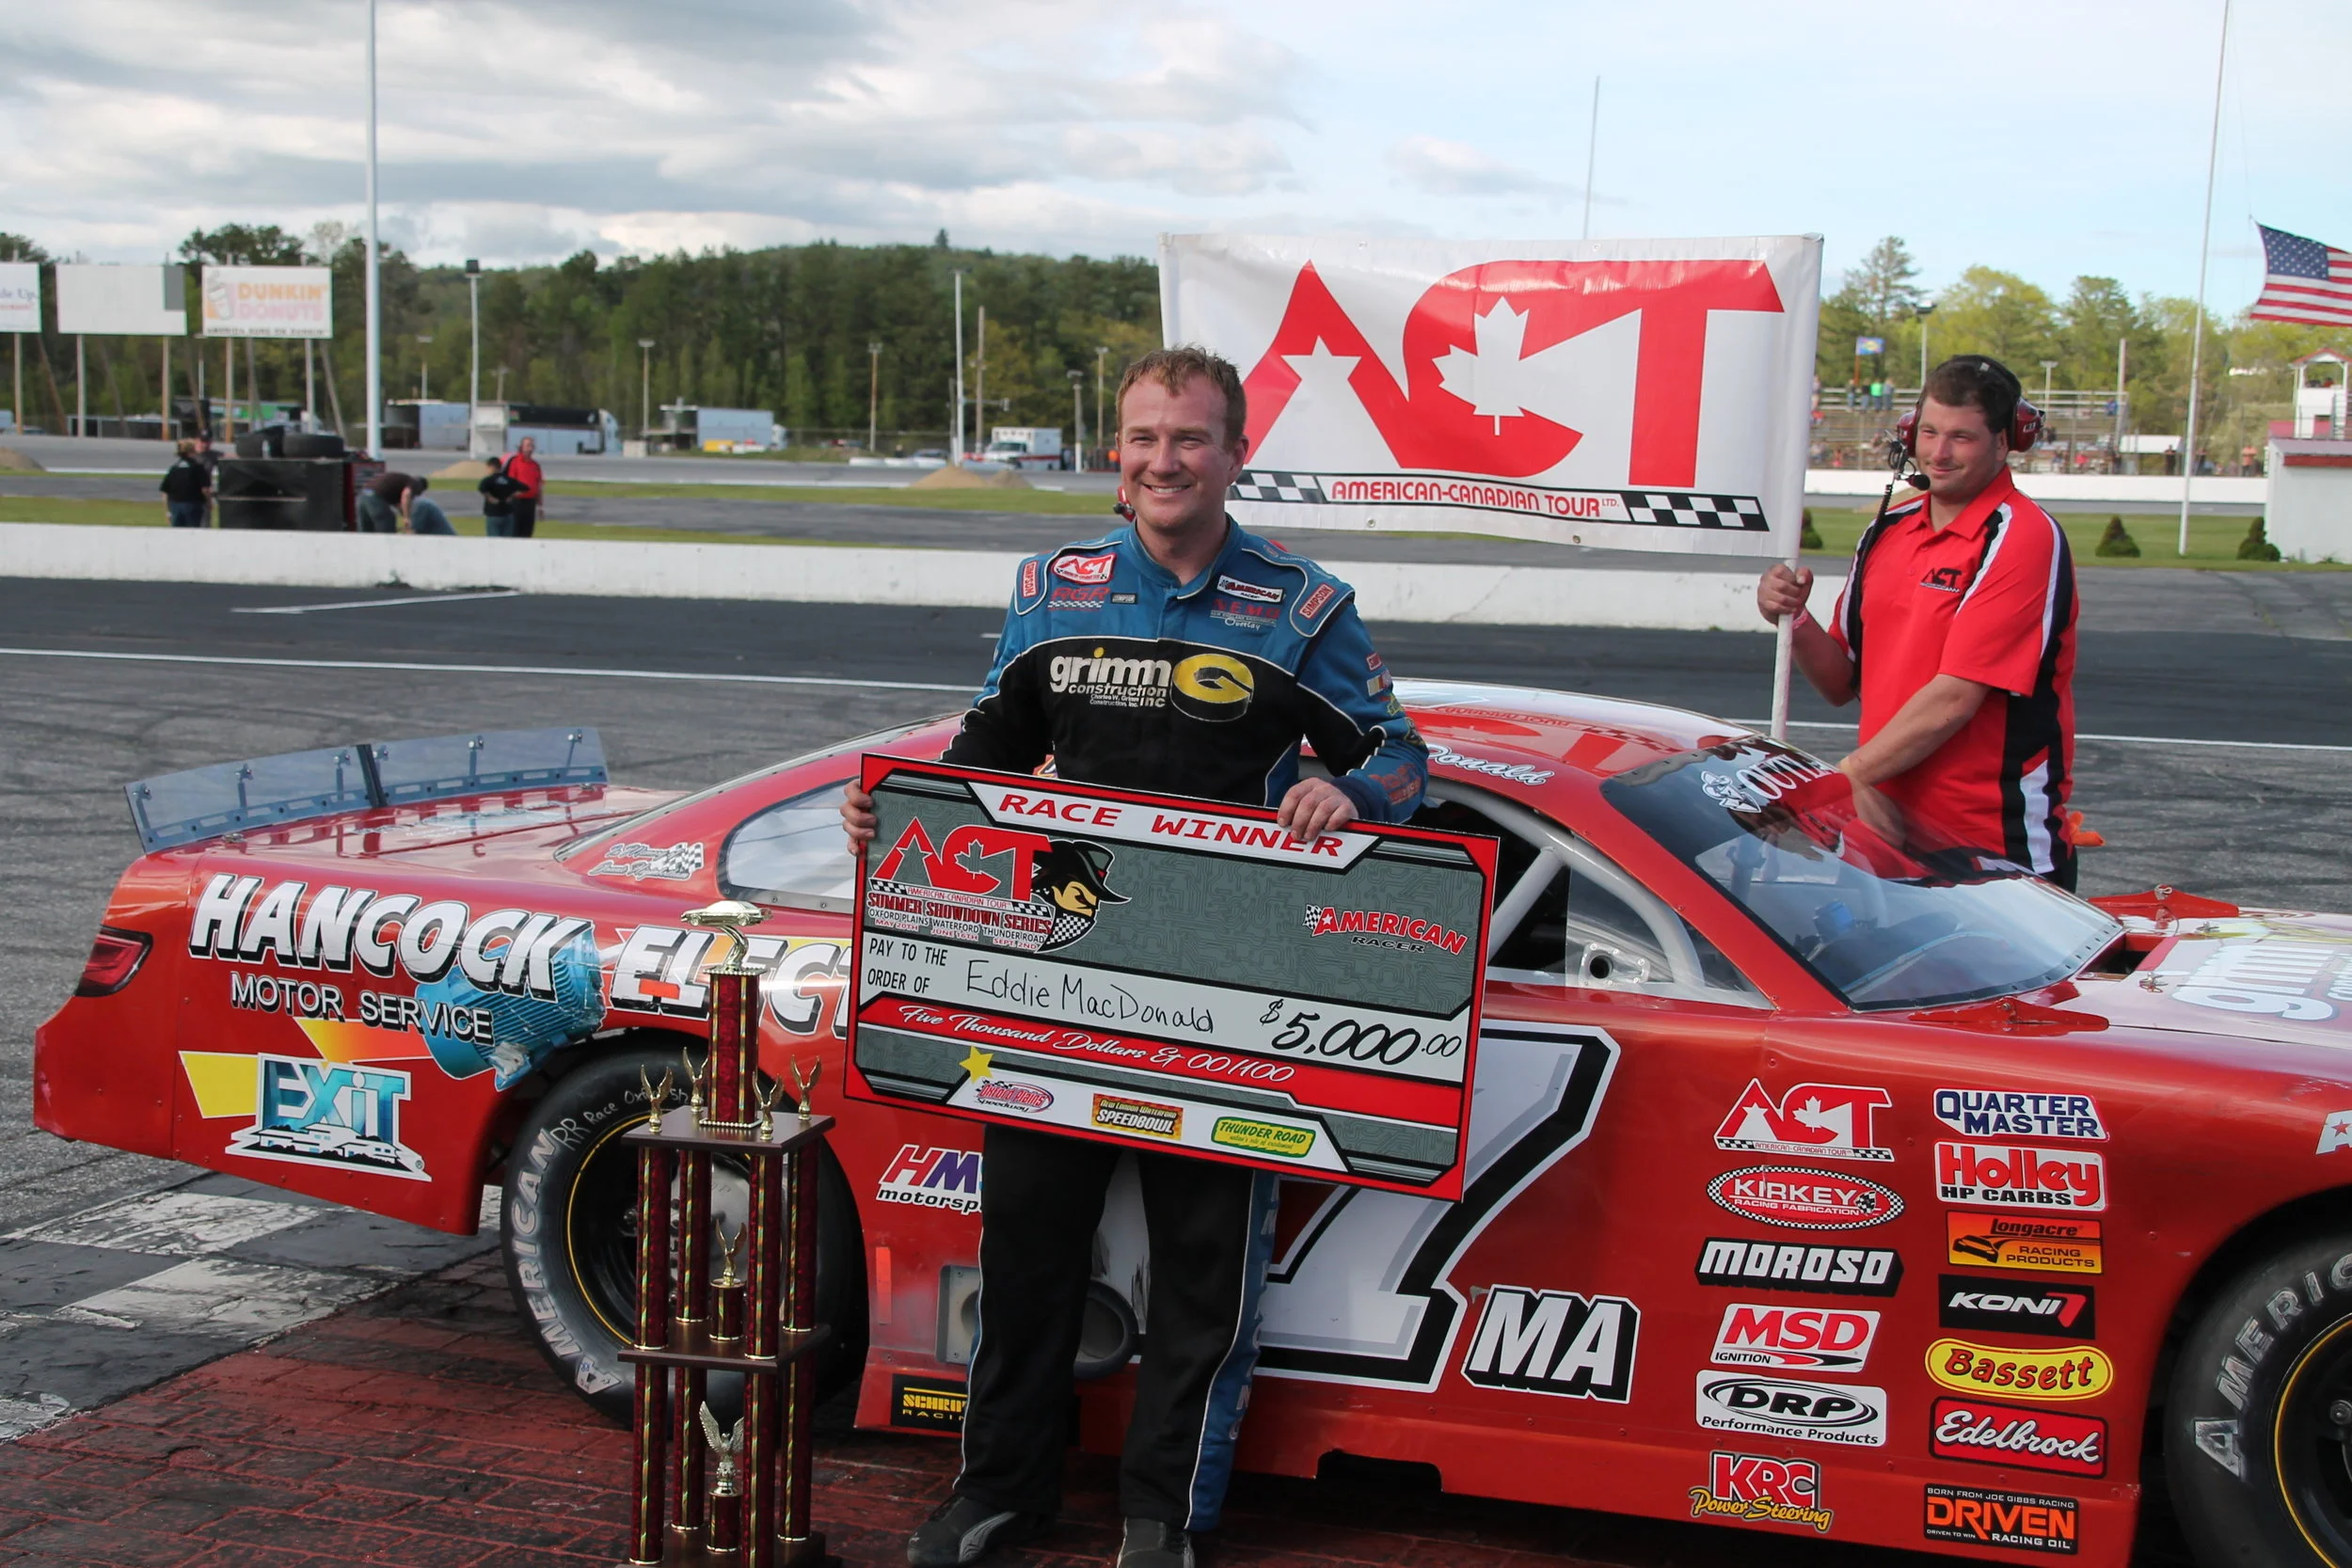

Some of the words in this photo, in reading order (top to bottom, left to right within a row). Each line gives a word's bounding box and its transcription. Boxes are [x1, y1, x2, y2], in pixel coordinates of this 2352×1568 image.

[239, 303, 324, 321] DONUTS
[1245, 259, 1785, 487] ACT
[1331, 481, 1540, 511] AMERICAN-CANADIAN
[1545, 495, 1599, 517] TOUR
[1921, 567, 1962, 588] ACT
[1052, 587, 1111, 601] RGR
[1302, 584, 1331, 619] SIMPSON
[1050, 647, 1171, 692] grimm
[1069, 683, 1168, 698] construction
[999, 794, 1122, 827] RACE
[1152, 815, 1344, 857] WINNER
[872, 816, 1054, 902] ACT
[867, 893, 923, 914] SUMMER
[926, 901, 1001, 927] SHOWDOWN
[1004, 913, 1053, 935] SERIES
[987, 899, 1008, 909] TOUR
[868, 909, 899, 921] OXFORD
[902, 913, 930, 926] PLAINS
[875, 919, 894, 927] MAY
[896, 922, 918, 931] 20TH
[932, 918, 979, 933] WATERFORD
[190, 872, 594, 1003] HANCOCK
[930, 928, 954, 938] JUNE
[956, 931, 978, 941] 16TH
[983, 927, 1020, 940] THUNDER
[1023, 932, 1045, 943] ROAD
[993, 938, 1015, 947] SEPT.
[1018, 942, 1038, 950] 2ND
[1311, 907, 1468, 956] AMERICAN
[868, 937, 893, 958] PAY
[901, 942, 916, 961] TO
[925, 946, 948, 967] THE
[1351, 936, 1424, 954] RACER
[612, 923, 850, 1039] ELC
[867, 968, 907, 990] ORDER
[914, 975, 930, 994] OF
[230, 972, 345, 1022] MOTOR
[359, 990, 496, 1046] SERVICE
[967, 959, 1050, 1009] Eddie
[1061, 973, 1214, 1035] MacDonald
[898, 1005, 945, 1026] Five
[948, 1013, 1051, 1044] Thousand
[1053, 1031, 1144, 1060] Dollars
[1186, 1052, 1296, 1083] 00/100
[976, 1097, 1029, 1113] Speedway
[980, 1083, 1013, 1101] Oxford
[1015, 1088, 1048, 1107] Plains
[1935, 1090, 2090, 1121] QUARTER
[583, 1102, 618, 1125] Race
[1096, 1109, 1174, 1134] SPEEDBOWL
[1718, 1080, 1892, 1149] ACT
[1963, 1112, 2100, 1137] MASTER
[1219, 1121, 1273, 1139] THUNDER
[1274, 1130, 1307, 1144] ROAD
[882, 1145, 983, 1195] HM
[1938, 1144, 2101, 1207] Holley
[878, 1188, 983, 1213] motorsp
[1734, 1179, 1857, 1206] KIRKEY
[1941, 1186, 1975, 1199] HP
[1982, 1189, 2072, 1206] CARBS
[1734, 1198, 1778, 1210] RACING
[1782, 1203, 1860, 1216] FABRICATION
[1990, 1218, 2078, 1237] Longacre
[512, 1129, 622, 1394] AMERICAN
[1698, 1240, 1895, 1286] MOROSO
[2006, 1254, 2095, 1268] PRODUCTS
[2019, 1245, 2081, 1258] RACING
[1948, 1291, 2063, 1315] KONI
[1465, 1288, 1635, 1398] MA
[1723, 1308, 1869, 1352] MSD
[1715, 1352, 1771, 1364] IGNITION
[1944, 1348, 2094, 1390] Bassett
[903, 1394, 966, 1413] SCHRO
[1727, 1386, 1856, 1418] DRP
[1701, 1416, 1803, 1437] Performance
[1807, 1428, 1879, 1445] Products
[1935, 1409, 2103, 1465] Edelbrock
[1714, 1453, 1816, 1510] KRC
[1690, 1487, 1749, 1516] Power
[1745, 1496, 1832, 1530] Steering
[1927, 1487, 1954, 1497] BORN
[1956, 1490, 1983, 1499] FROM
[1985, 1493, 2004, 1502] JOE
[2007, 1496, 2036, 1505] GIBBS
[2039, 1498, 2074, 1509] RACING
[1927, 1496, 2074, 1541] DRIVEN
[1926, 1528, 1951, 1537] DRIVEN
[1992, 1532, 2042, 1546] RACING
[2048, 1539, 2071, 1549] OIL
